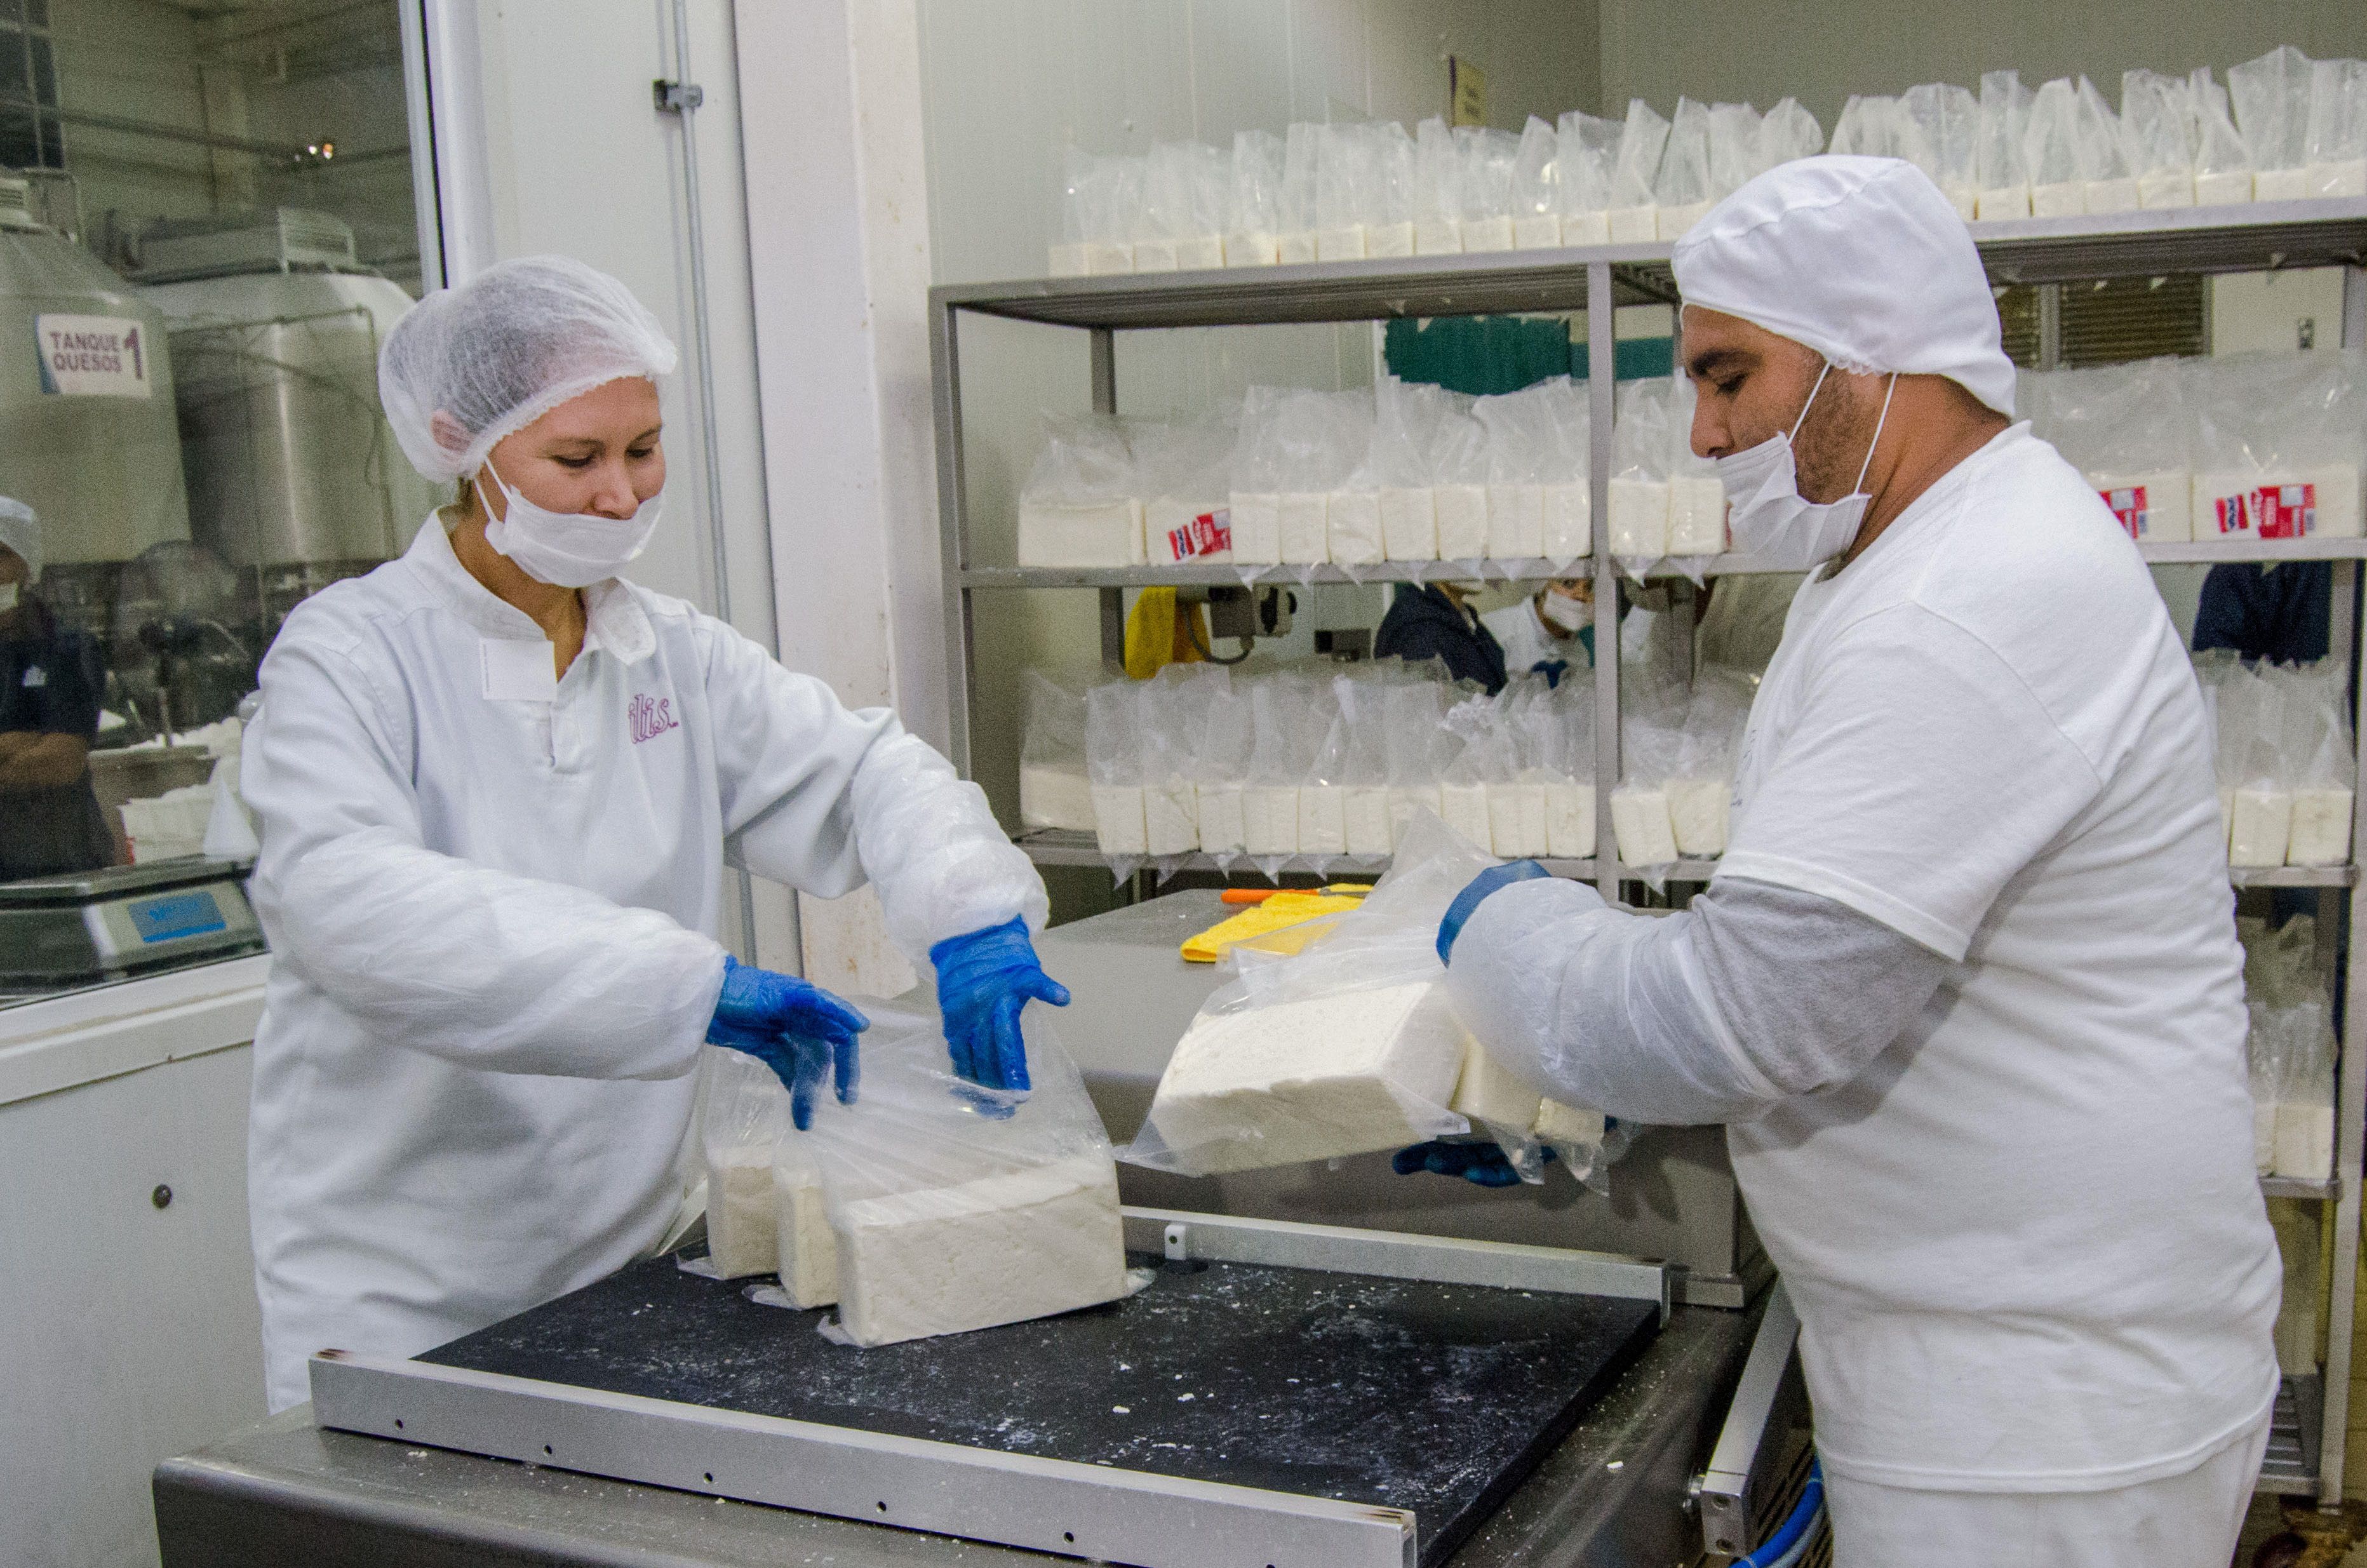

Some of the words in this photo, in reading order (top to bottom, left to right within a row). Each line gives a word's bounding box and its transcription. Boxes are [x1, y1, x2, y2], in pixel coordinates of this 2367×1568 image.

[50, 331, 119, 351] TANQUE
[53, 352, 122, 373] QUESOS
[124, 327, 143, 380] 1
